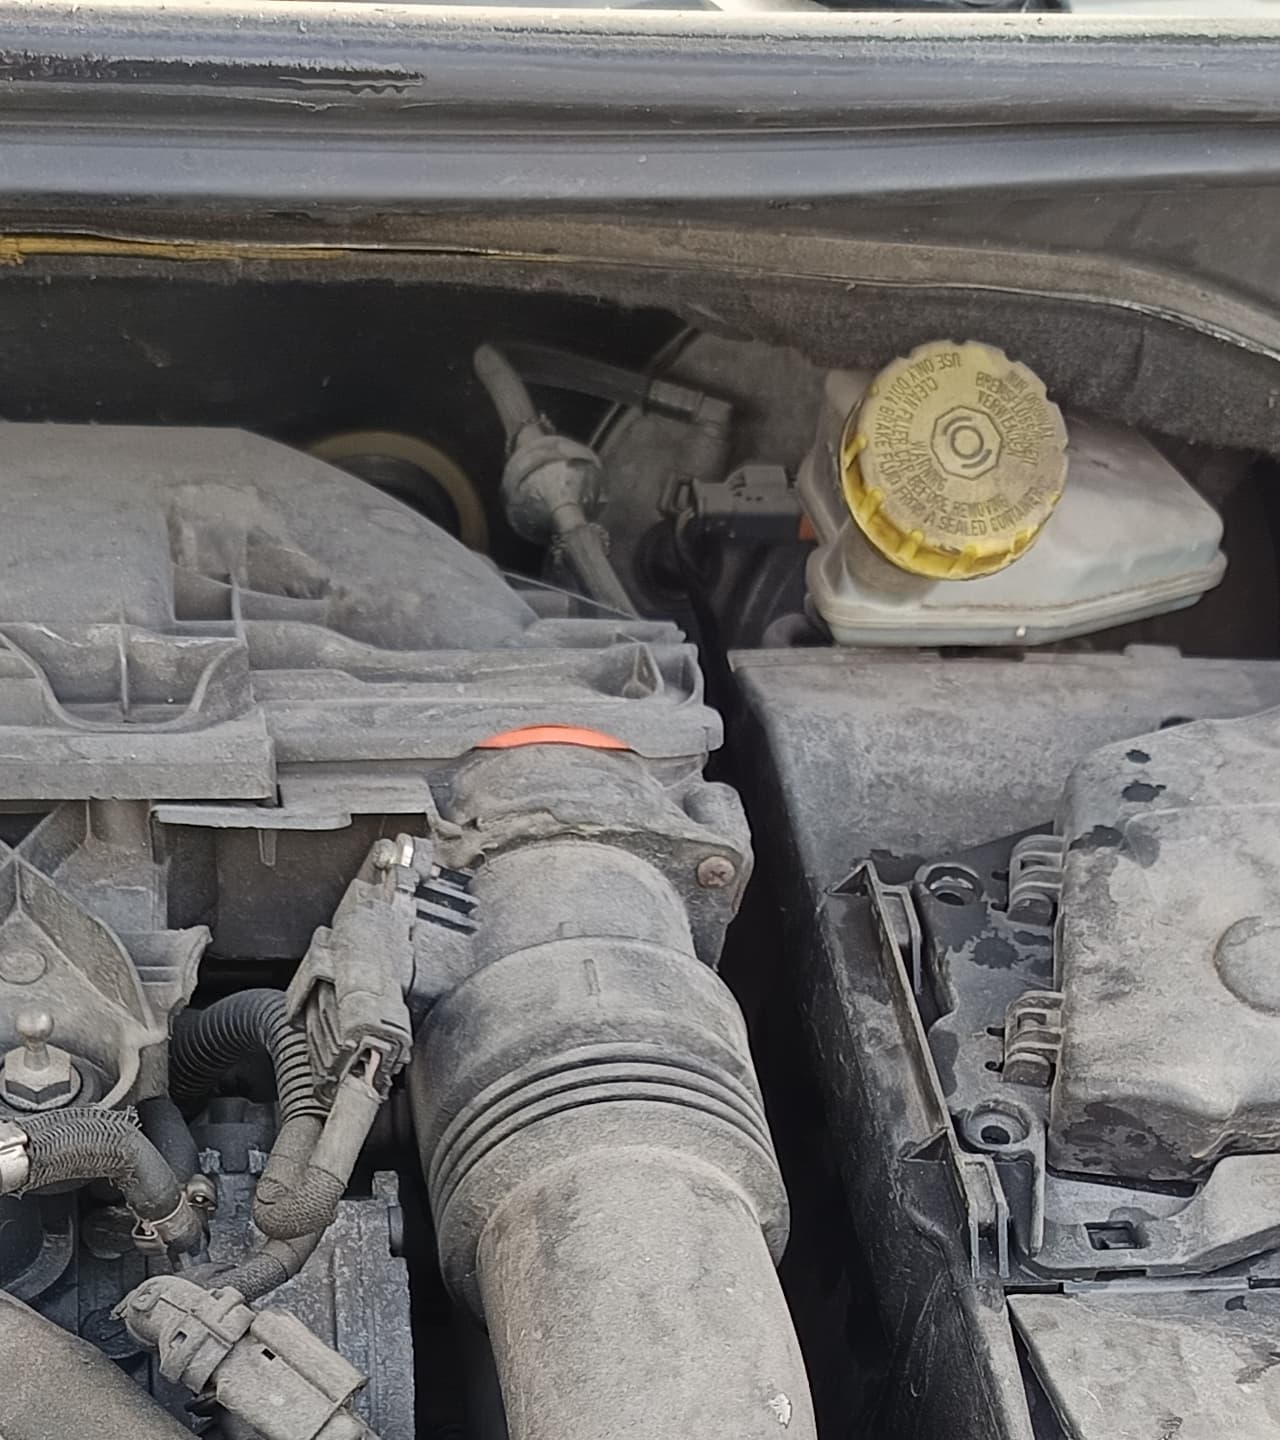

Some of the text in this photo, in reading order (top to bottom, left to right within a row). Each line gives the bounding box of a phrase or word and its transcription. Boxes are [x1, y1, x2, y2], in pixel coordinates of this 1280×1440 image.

[907, 359, 935, 384] ONLY
[935, 352, 962, 370] USE
[884, 376, 911, 406] DOT4
[903, 376, 938, 410] CLEAN
[874, 406, 896, 448] BRAKE
[891, 406, 914, 446] FILLER
[876, 452, 902, 486] FLUID
[894, 449, 916, 473] CAP
[906, 473, 950, 515] BEFORE
[923, 510, 937, 525] A
[938, 515, 988, 537] SEALED
